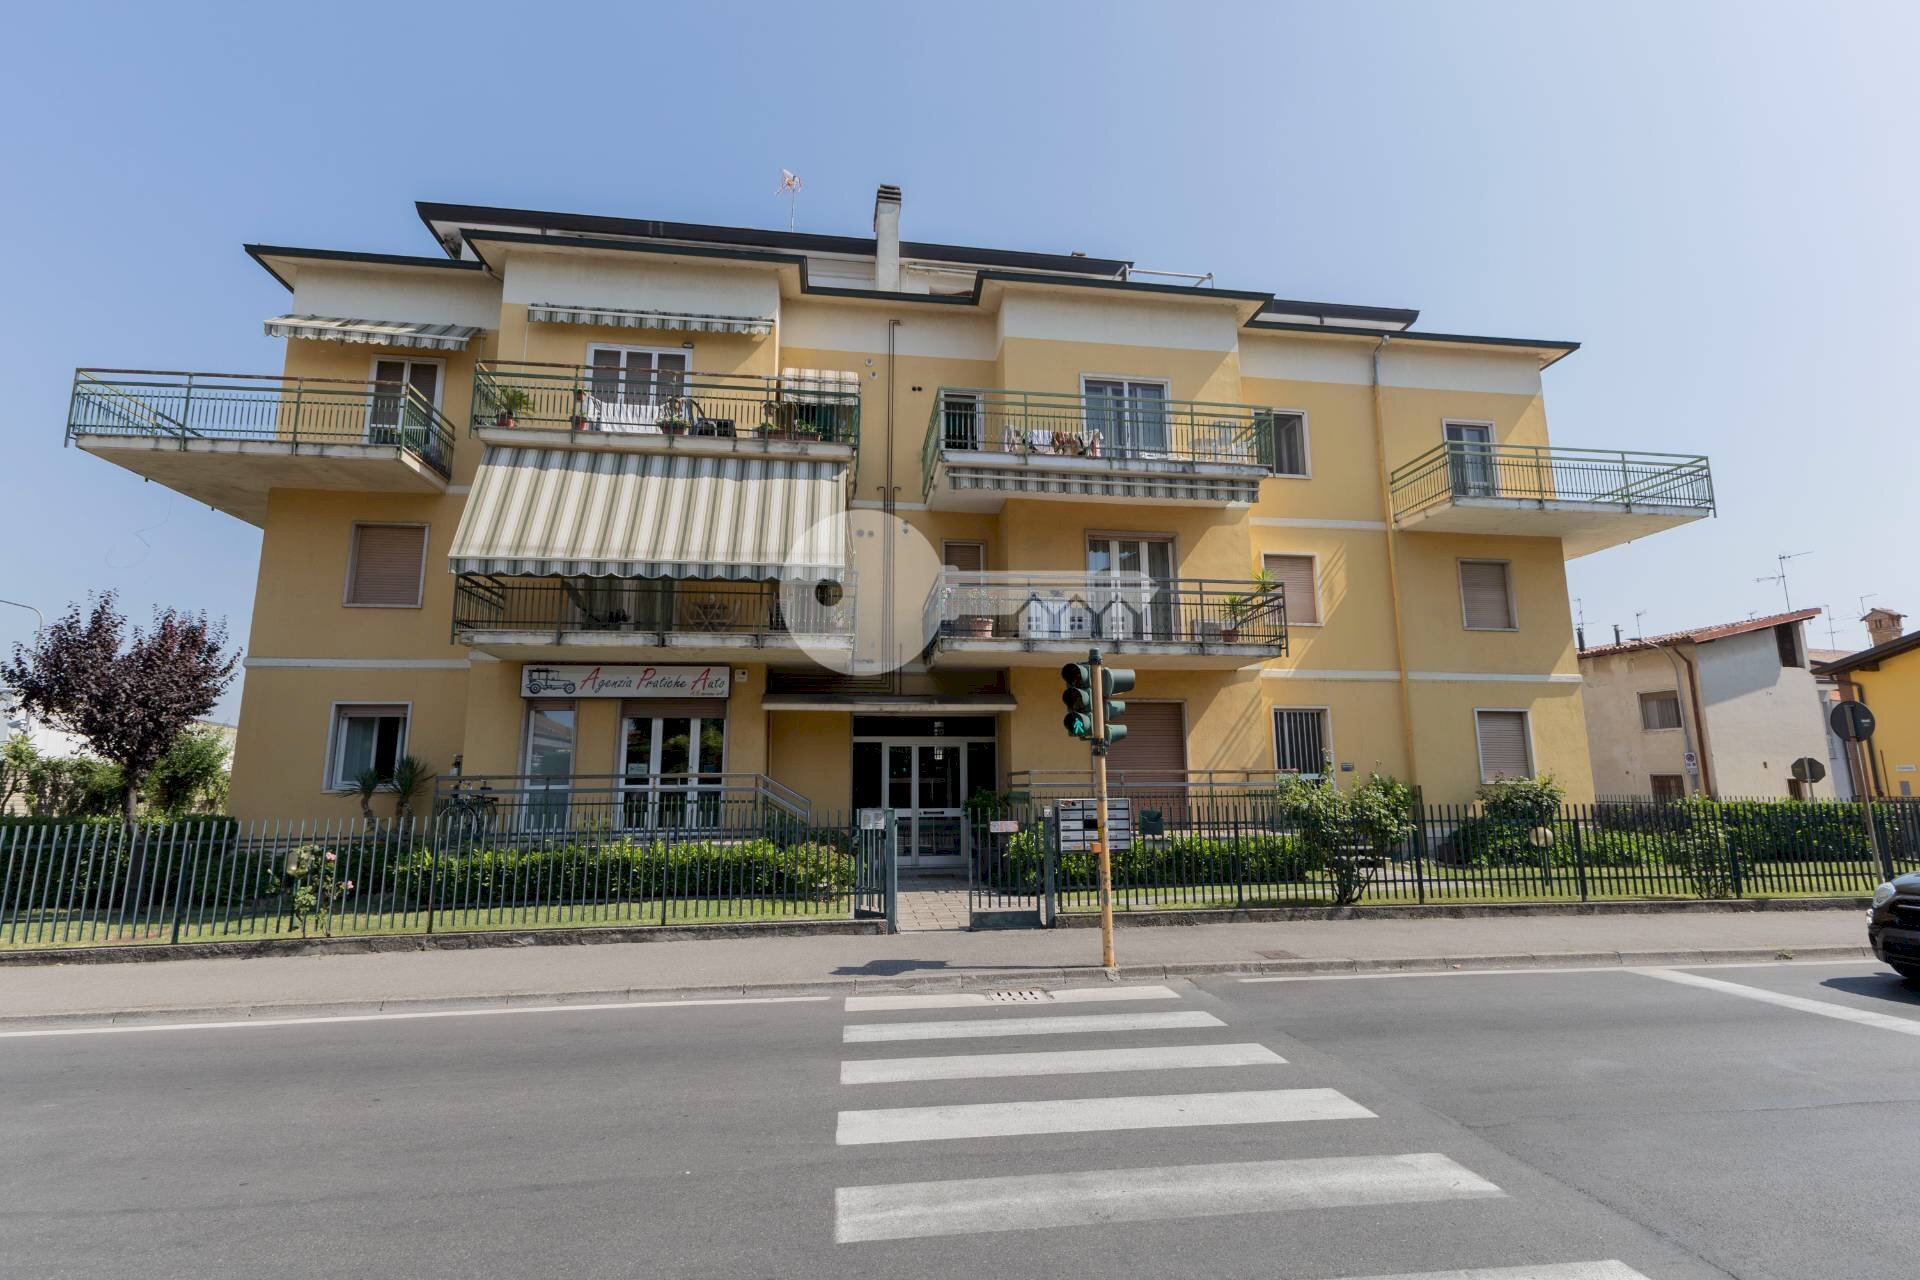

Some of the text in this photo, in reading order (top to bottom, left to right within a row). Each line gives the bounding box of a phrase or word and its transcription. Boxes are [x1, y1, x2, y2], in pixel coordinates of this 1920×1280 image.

[580, 667, 725, 693] Agenzia Pratiche Auto
